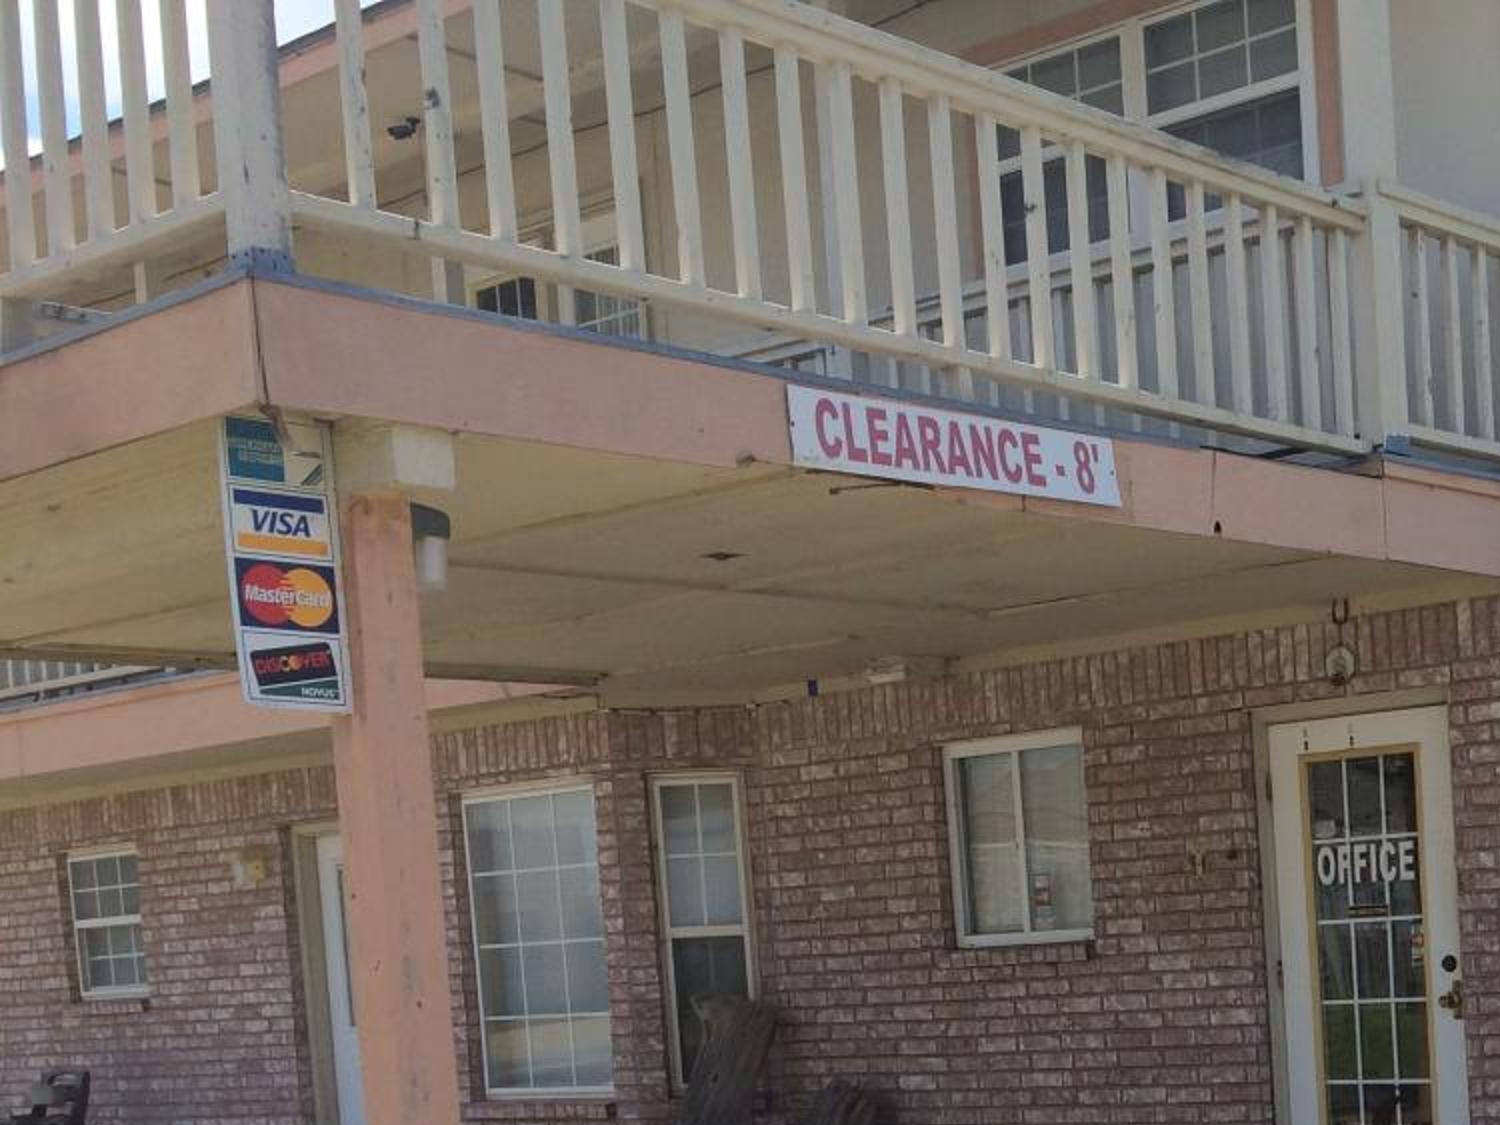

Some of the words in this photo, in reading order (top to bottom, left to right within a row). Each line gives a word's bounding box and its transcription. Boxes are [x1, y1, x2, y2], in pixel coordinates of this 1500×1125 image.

[815, 398, 1047, 488] CLEARANCE
[251, 509, 312, 538] VISA
[245, 584, 331, 608] MasterCard
[1317, 840, 1415, 885] OFFICE
